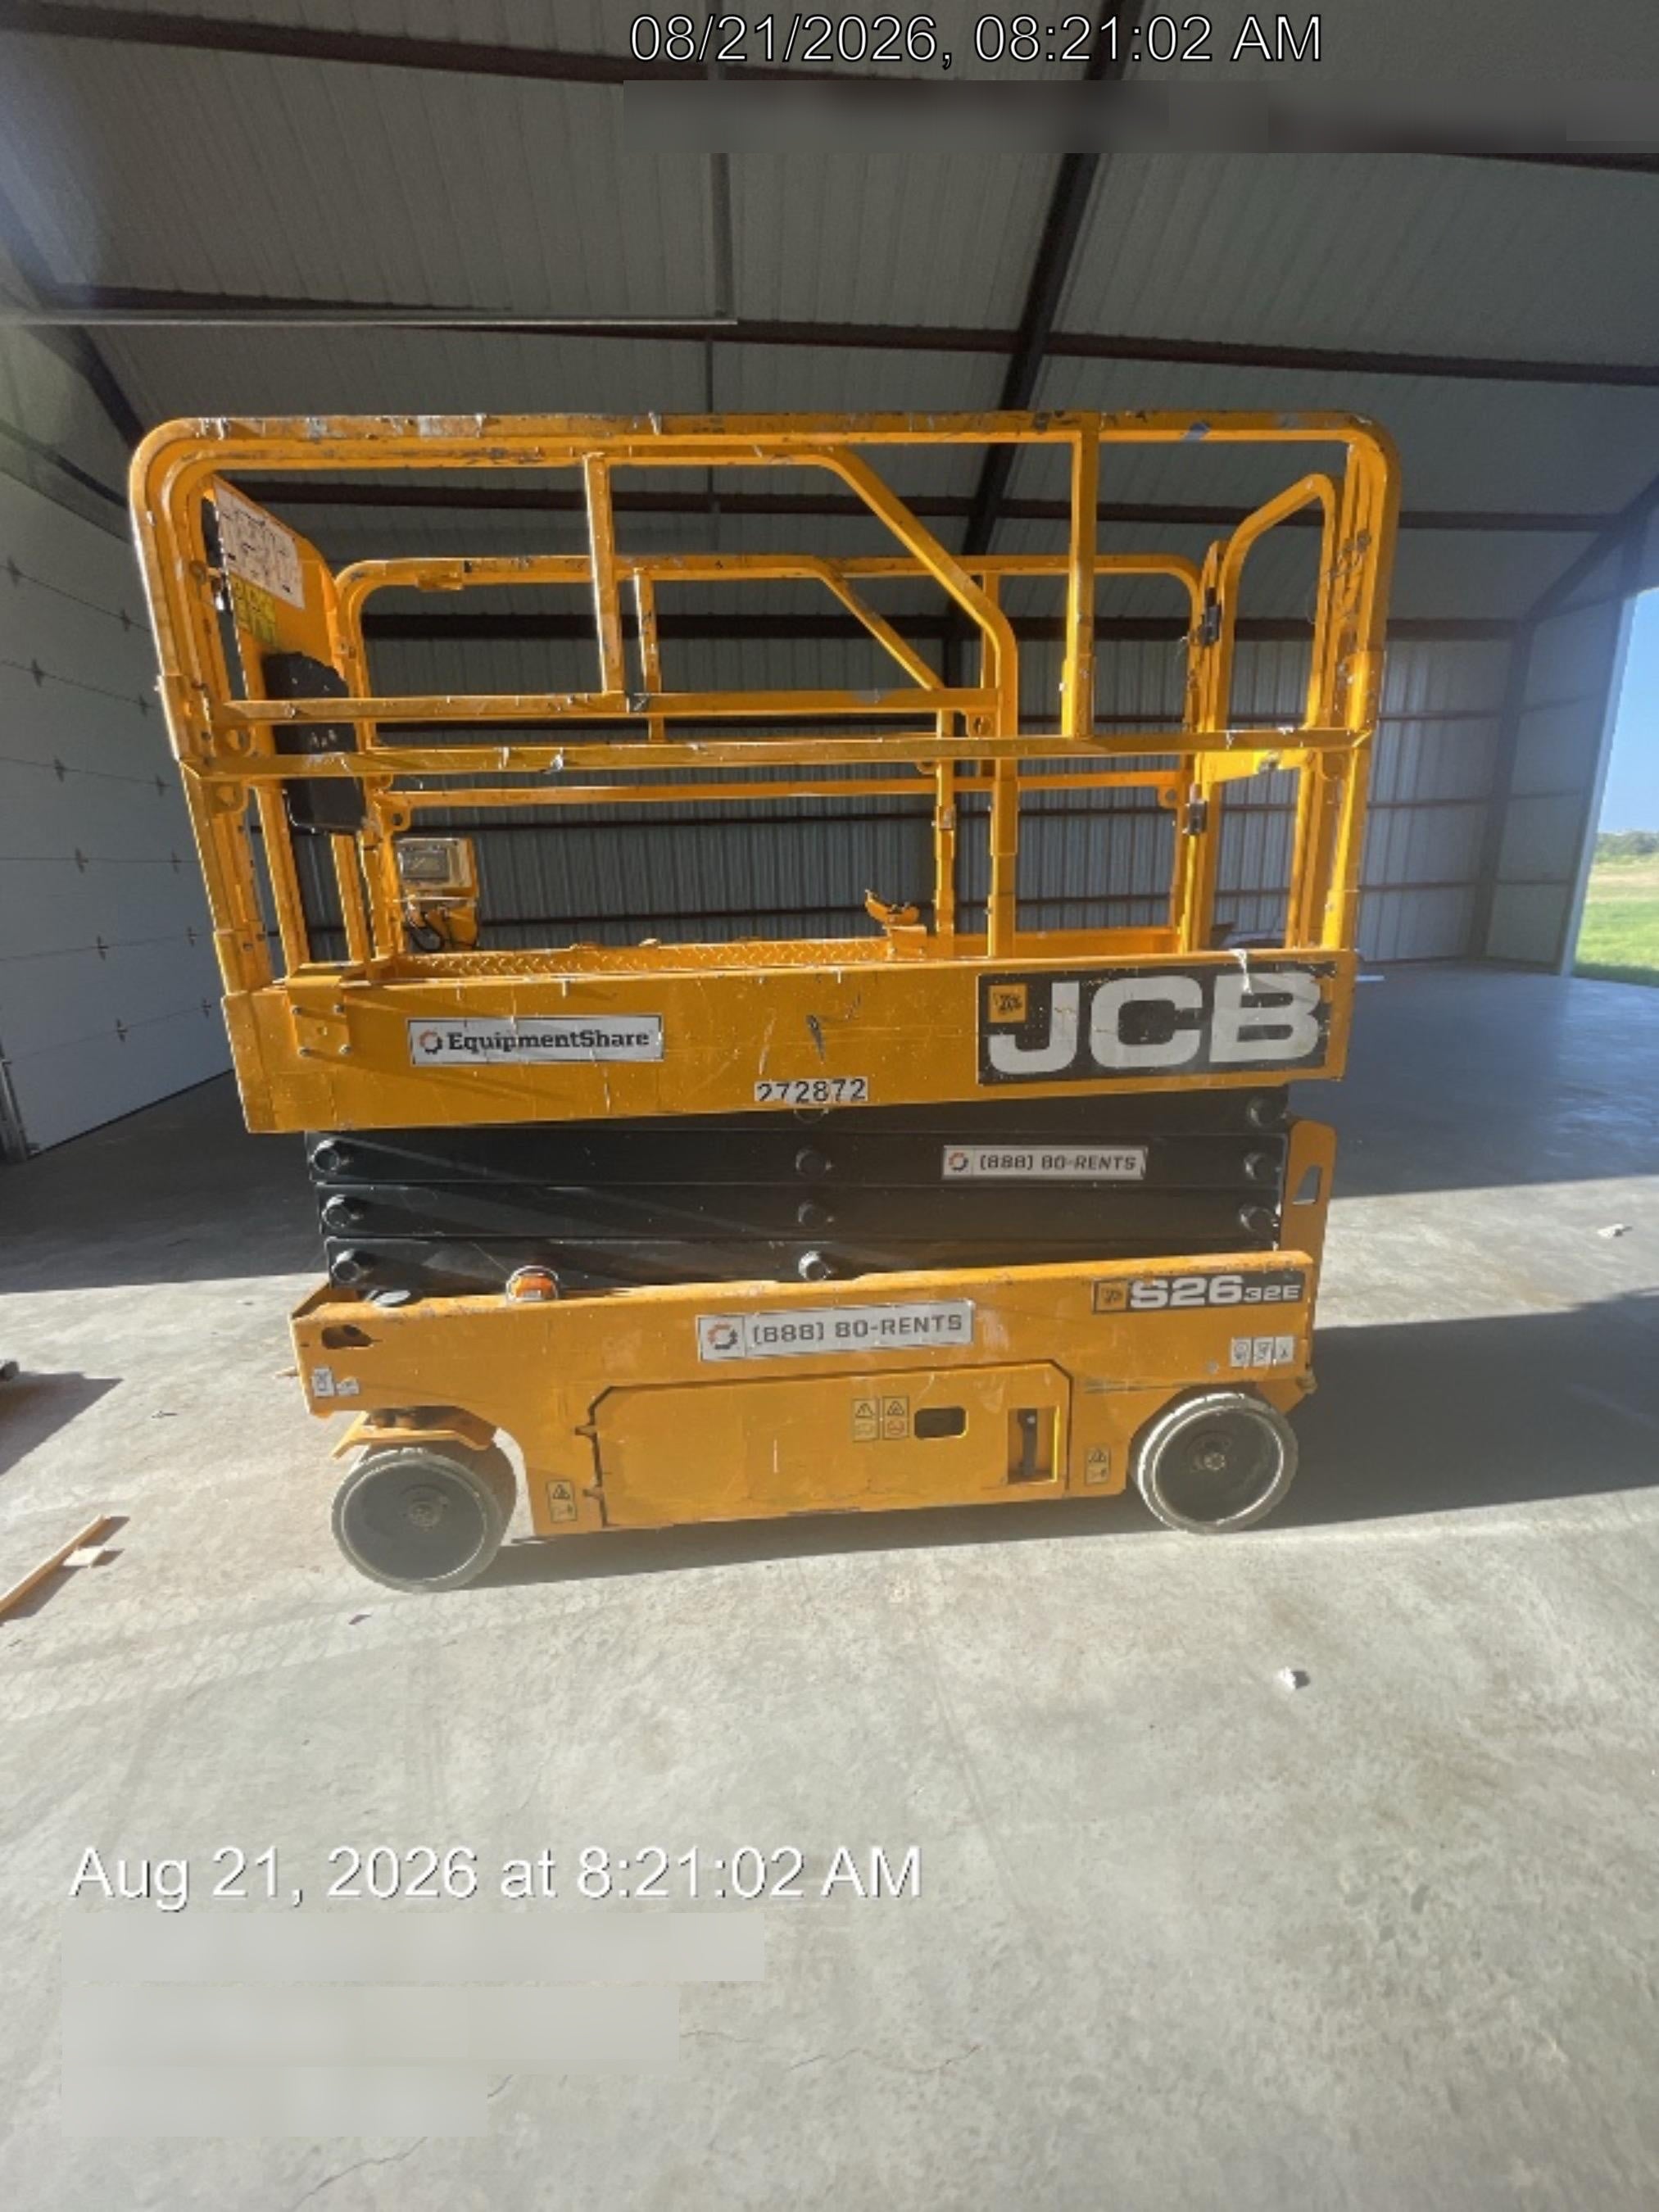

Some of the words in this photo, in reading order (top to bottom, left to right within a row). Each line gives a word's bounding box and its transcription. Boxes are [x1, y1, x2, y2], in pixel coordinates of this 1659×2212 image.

[988, 972, 1321, 1074] JCB
[447, 1029, 650, 1054] EquipmentShare
[757, 1078, 866, 1104] 272872
[1041, 1154, 1137, 1171] 80-RENTS
[835, 1313, 963, 1339] 80-RENTS
